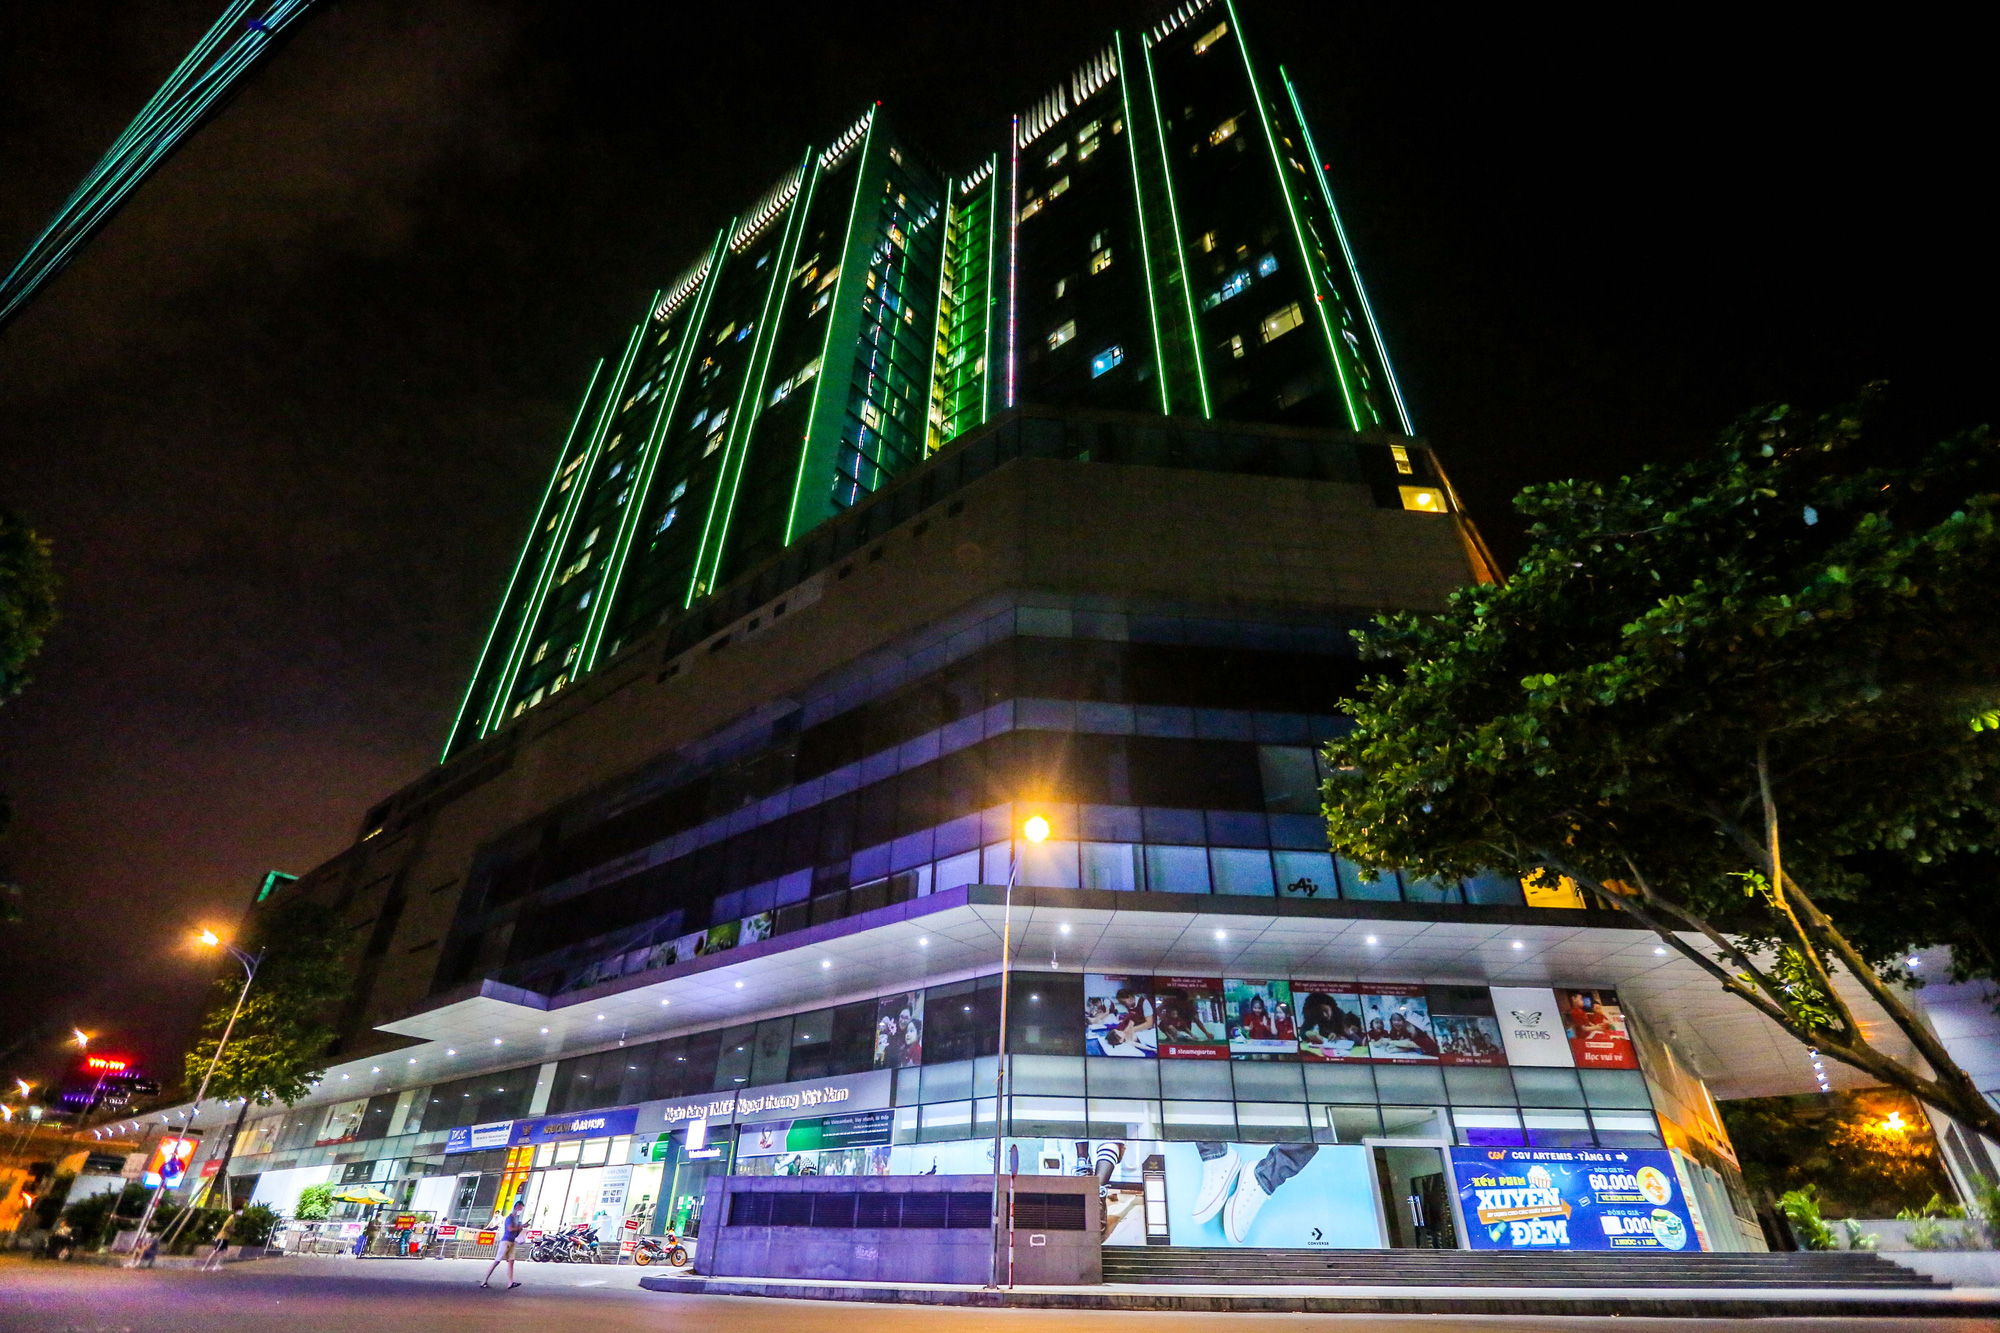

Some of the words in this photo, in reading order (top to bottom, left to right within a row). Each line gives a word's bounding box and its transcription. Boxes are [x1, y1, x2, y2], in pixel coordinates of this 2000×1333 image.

[1514, 1030, 1551, 1040] ARTEMIS
[1585, 1052, 1599, 1062] Học
[801, 1090, 821, 1105] Việt
[823, 1087, 849, 1103] Nam
[1511, 1152, 1530, 1160] CGV
[1533, 1152, 1573, 1161] ARTEMIS
[1605, 1154, 1612, 1162] 6
[1475, 1184, 1561, 1210] XUYÊN
[1511, 1217, 1570, 1246] ĐÊM
